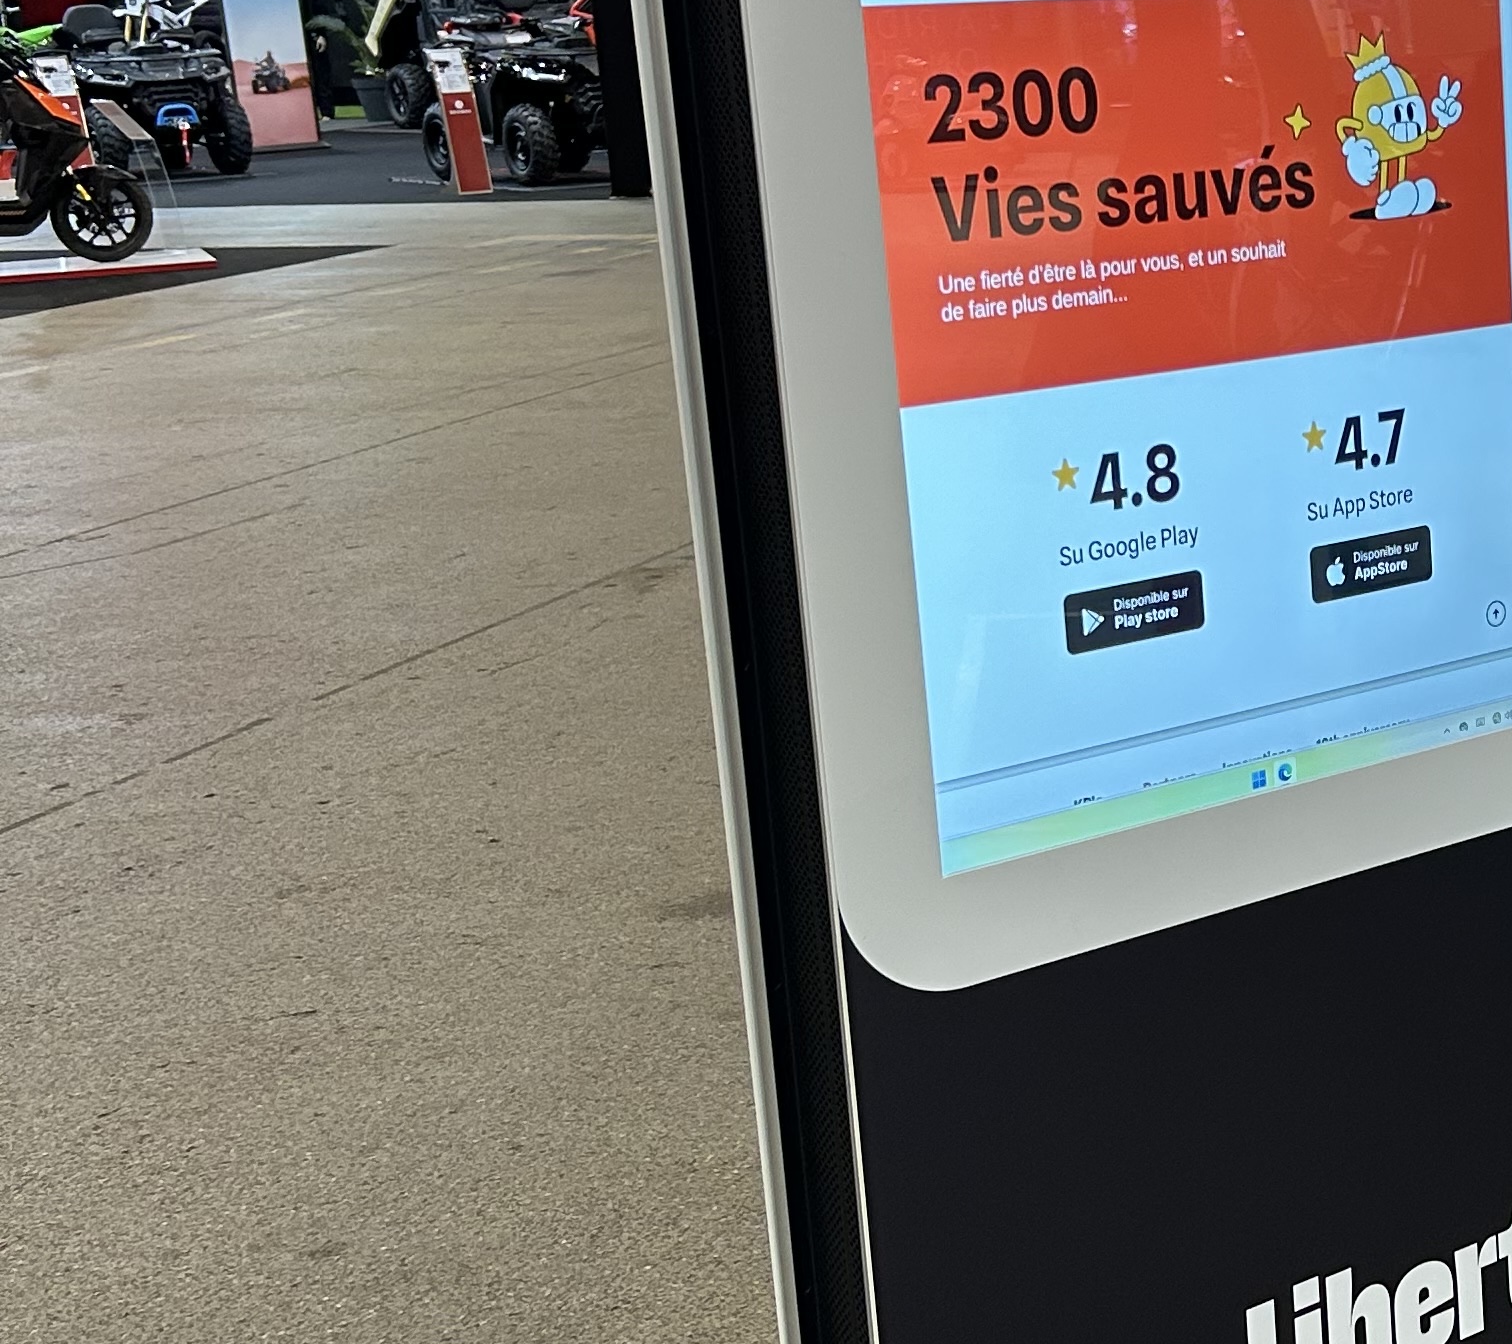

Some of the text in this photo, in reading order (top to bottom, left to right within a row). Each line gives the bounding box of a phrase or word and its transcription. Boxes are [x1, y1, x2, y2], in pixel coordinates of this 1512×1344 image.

[924, 66, 1099, 145] 2300
[931, 145, 1316, 243] Vies sauvés
[938, 240, 1288, 295] Une fierté d'être là pour vous, et un souhait
[940, 285, 1129, 323] de faire plus demain...
[1333, 407, 1406, 471] 4.7
[1089, 442, 1181, 510] 4.8
[1306, 486, 1414, 522] Su App Store
[1059, 524, 1200, 567] Su Google Play
[1352, 540, 1420, 564] Disponible sur
[1353, 559, 1408, 582] AppStore
[1113, 586, 1190, 613] Disponible sur
[1113, 605, 1179, 630] Play store
